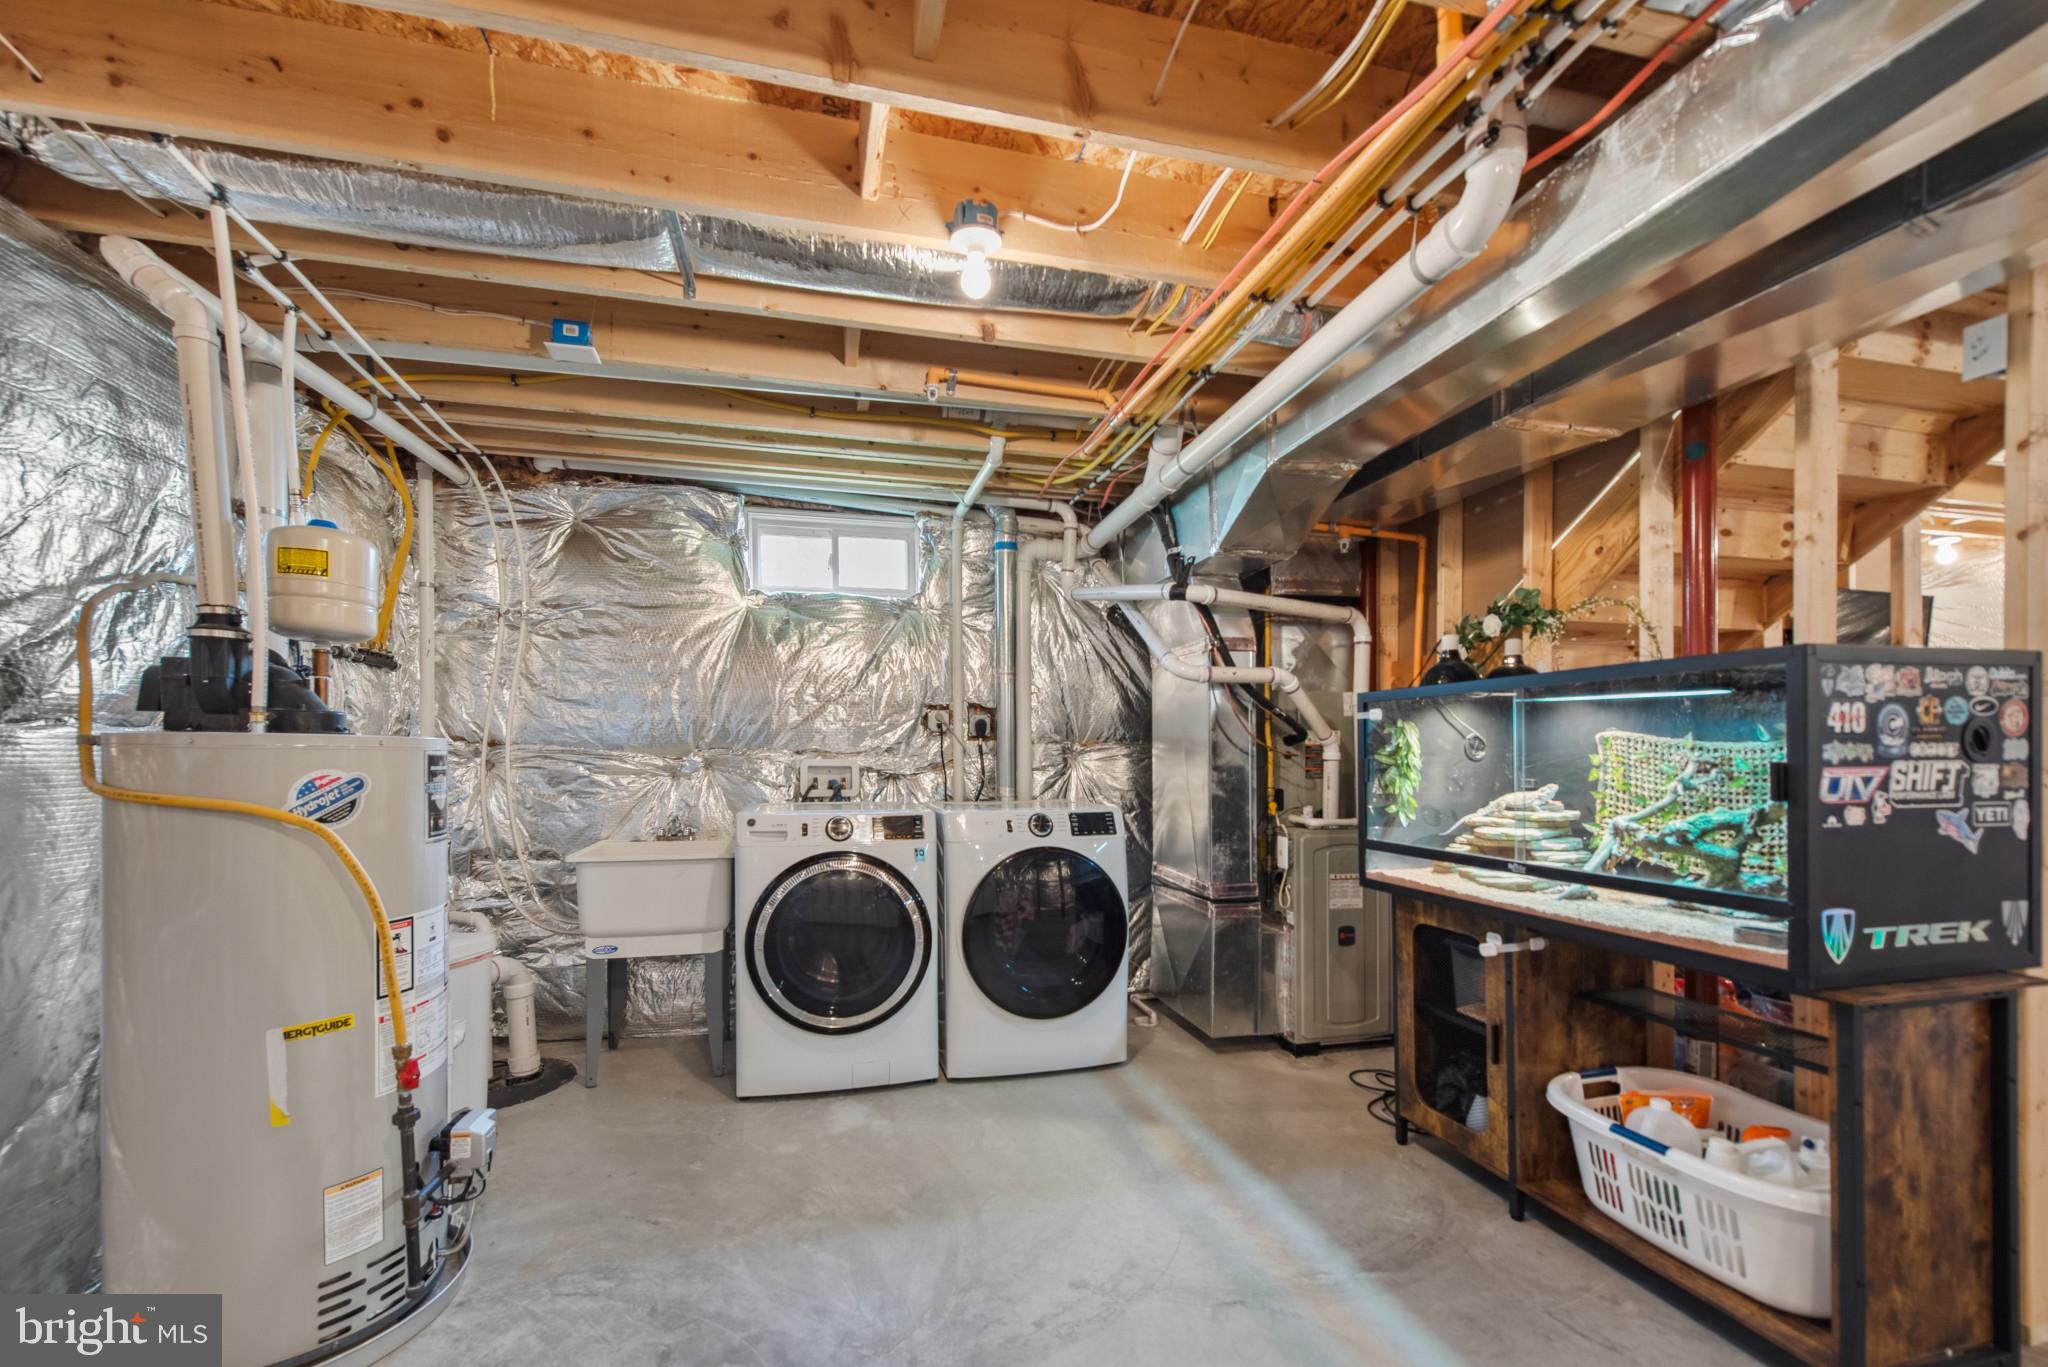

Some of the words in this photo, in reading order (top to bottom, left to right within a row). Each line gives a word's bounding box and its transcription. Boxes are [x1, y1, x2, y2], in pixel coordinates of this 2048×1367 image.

[1827, 701, 1866, 733] 410
[1891, 763, 1962, 791] SHIFT
[292, 788, 341, 817] Hydrojet
[1976, 806, 2008, 822] YETI
[1862, 919, 1992, 949] TREK
